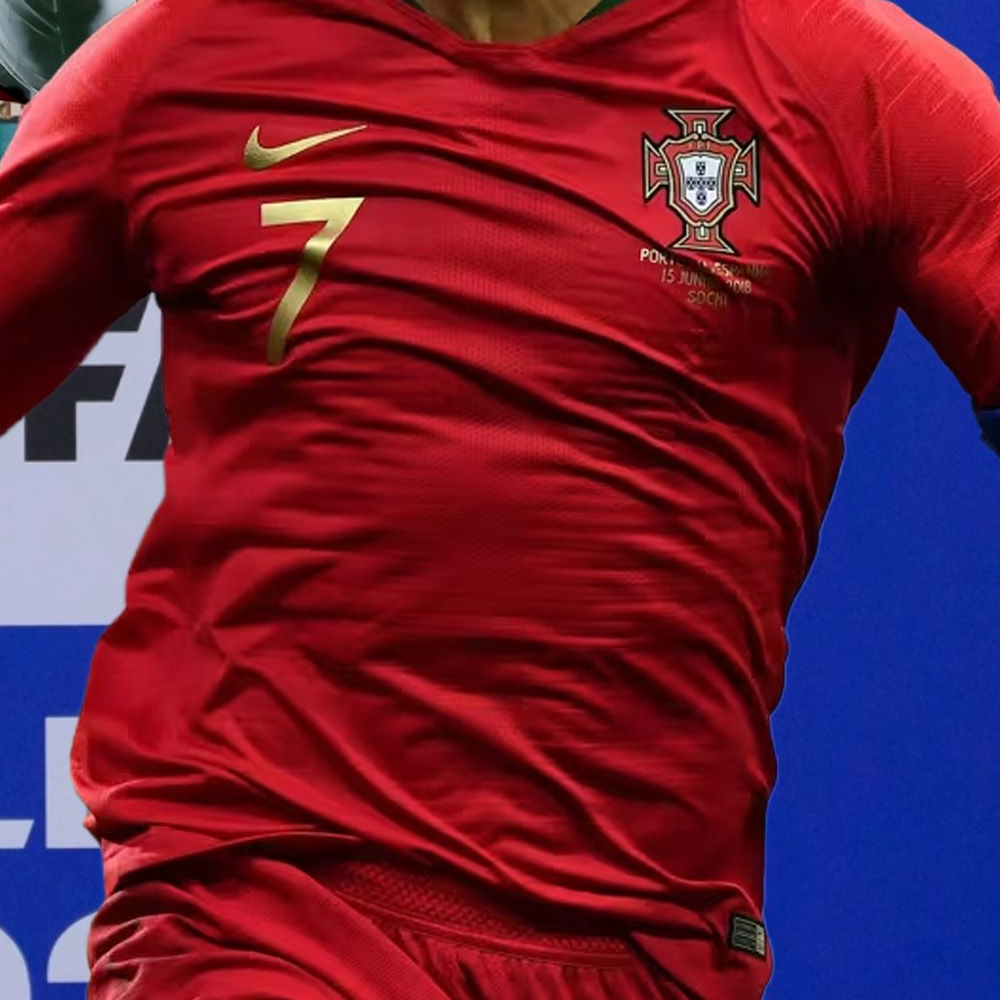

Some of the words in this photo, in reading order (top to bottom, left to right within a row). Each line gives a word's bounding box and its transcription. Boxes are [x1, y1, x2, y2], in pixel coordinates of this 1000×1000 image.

[260, 196, 366, 367] 7
[660, 267, 676, 284] 15
[687, 289, 729, 308] SOCHI
